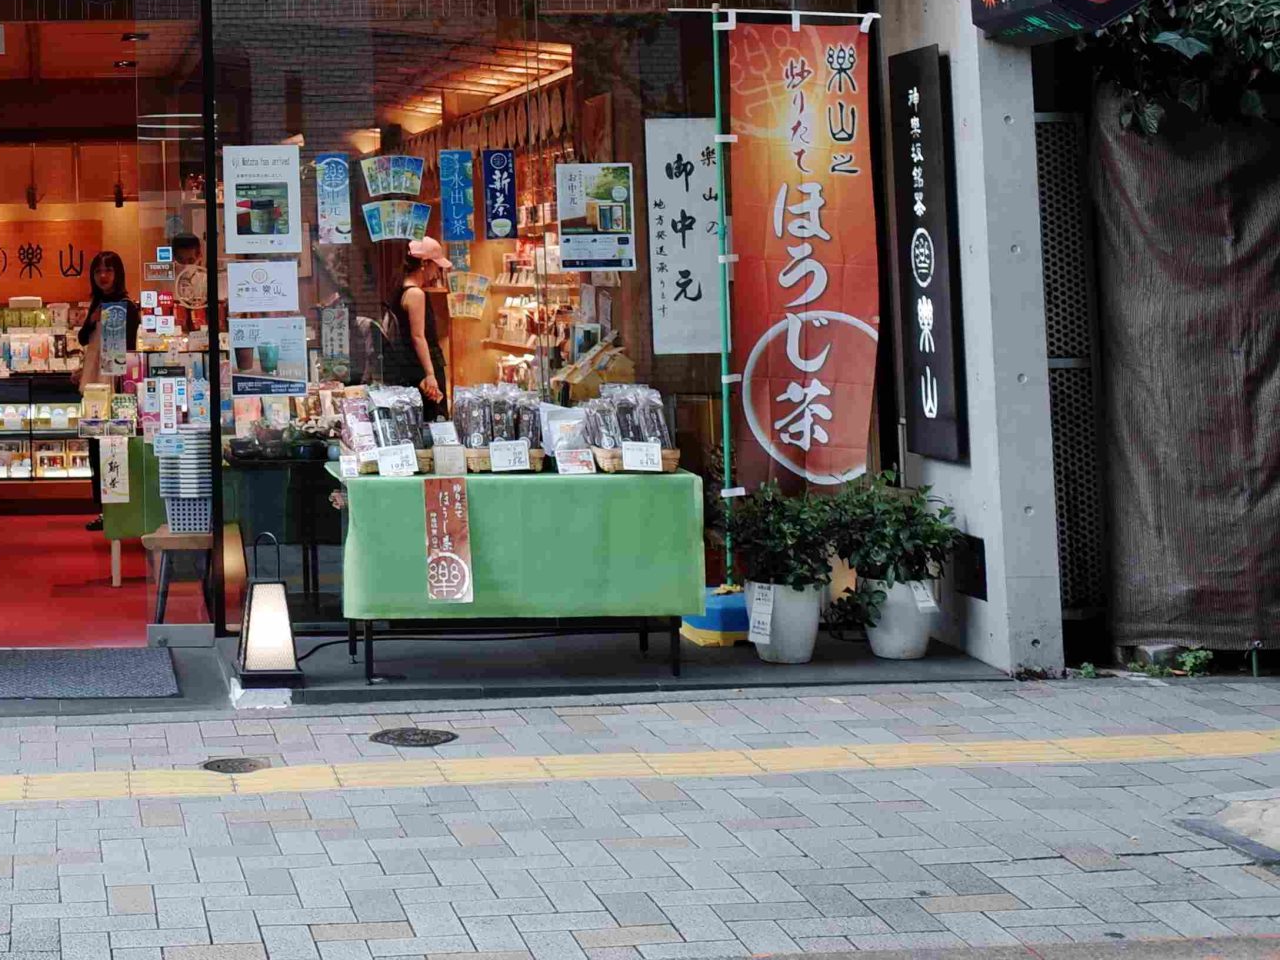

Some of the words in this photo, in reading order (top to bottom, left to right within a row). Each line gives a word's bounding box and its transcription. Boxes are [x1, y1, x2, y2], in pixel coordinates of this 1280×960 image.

[784, 57, 814, 175] 炒りたて
[450, 173, 466, 236] 水出し茶
[488, 169, 511, 217] 新茶
[665, 152, 703, 302] 御中元
[772, 181, 834, 452] ほうじ茶
